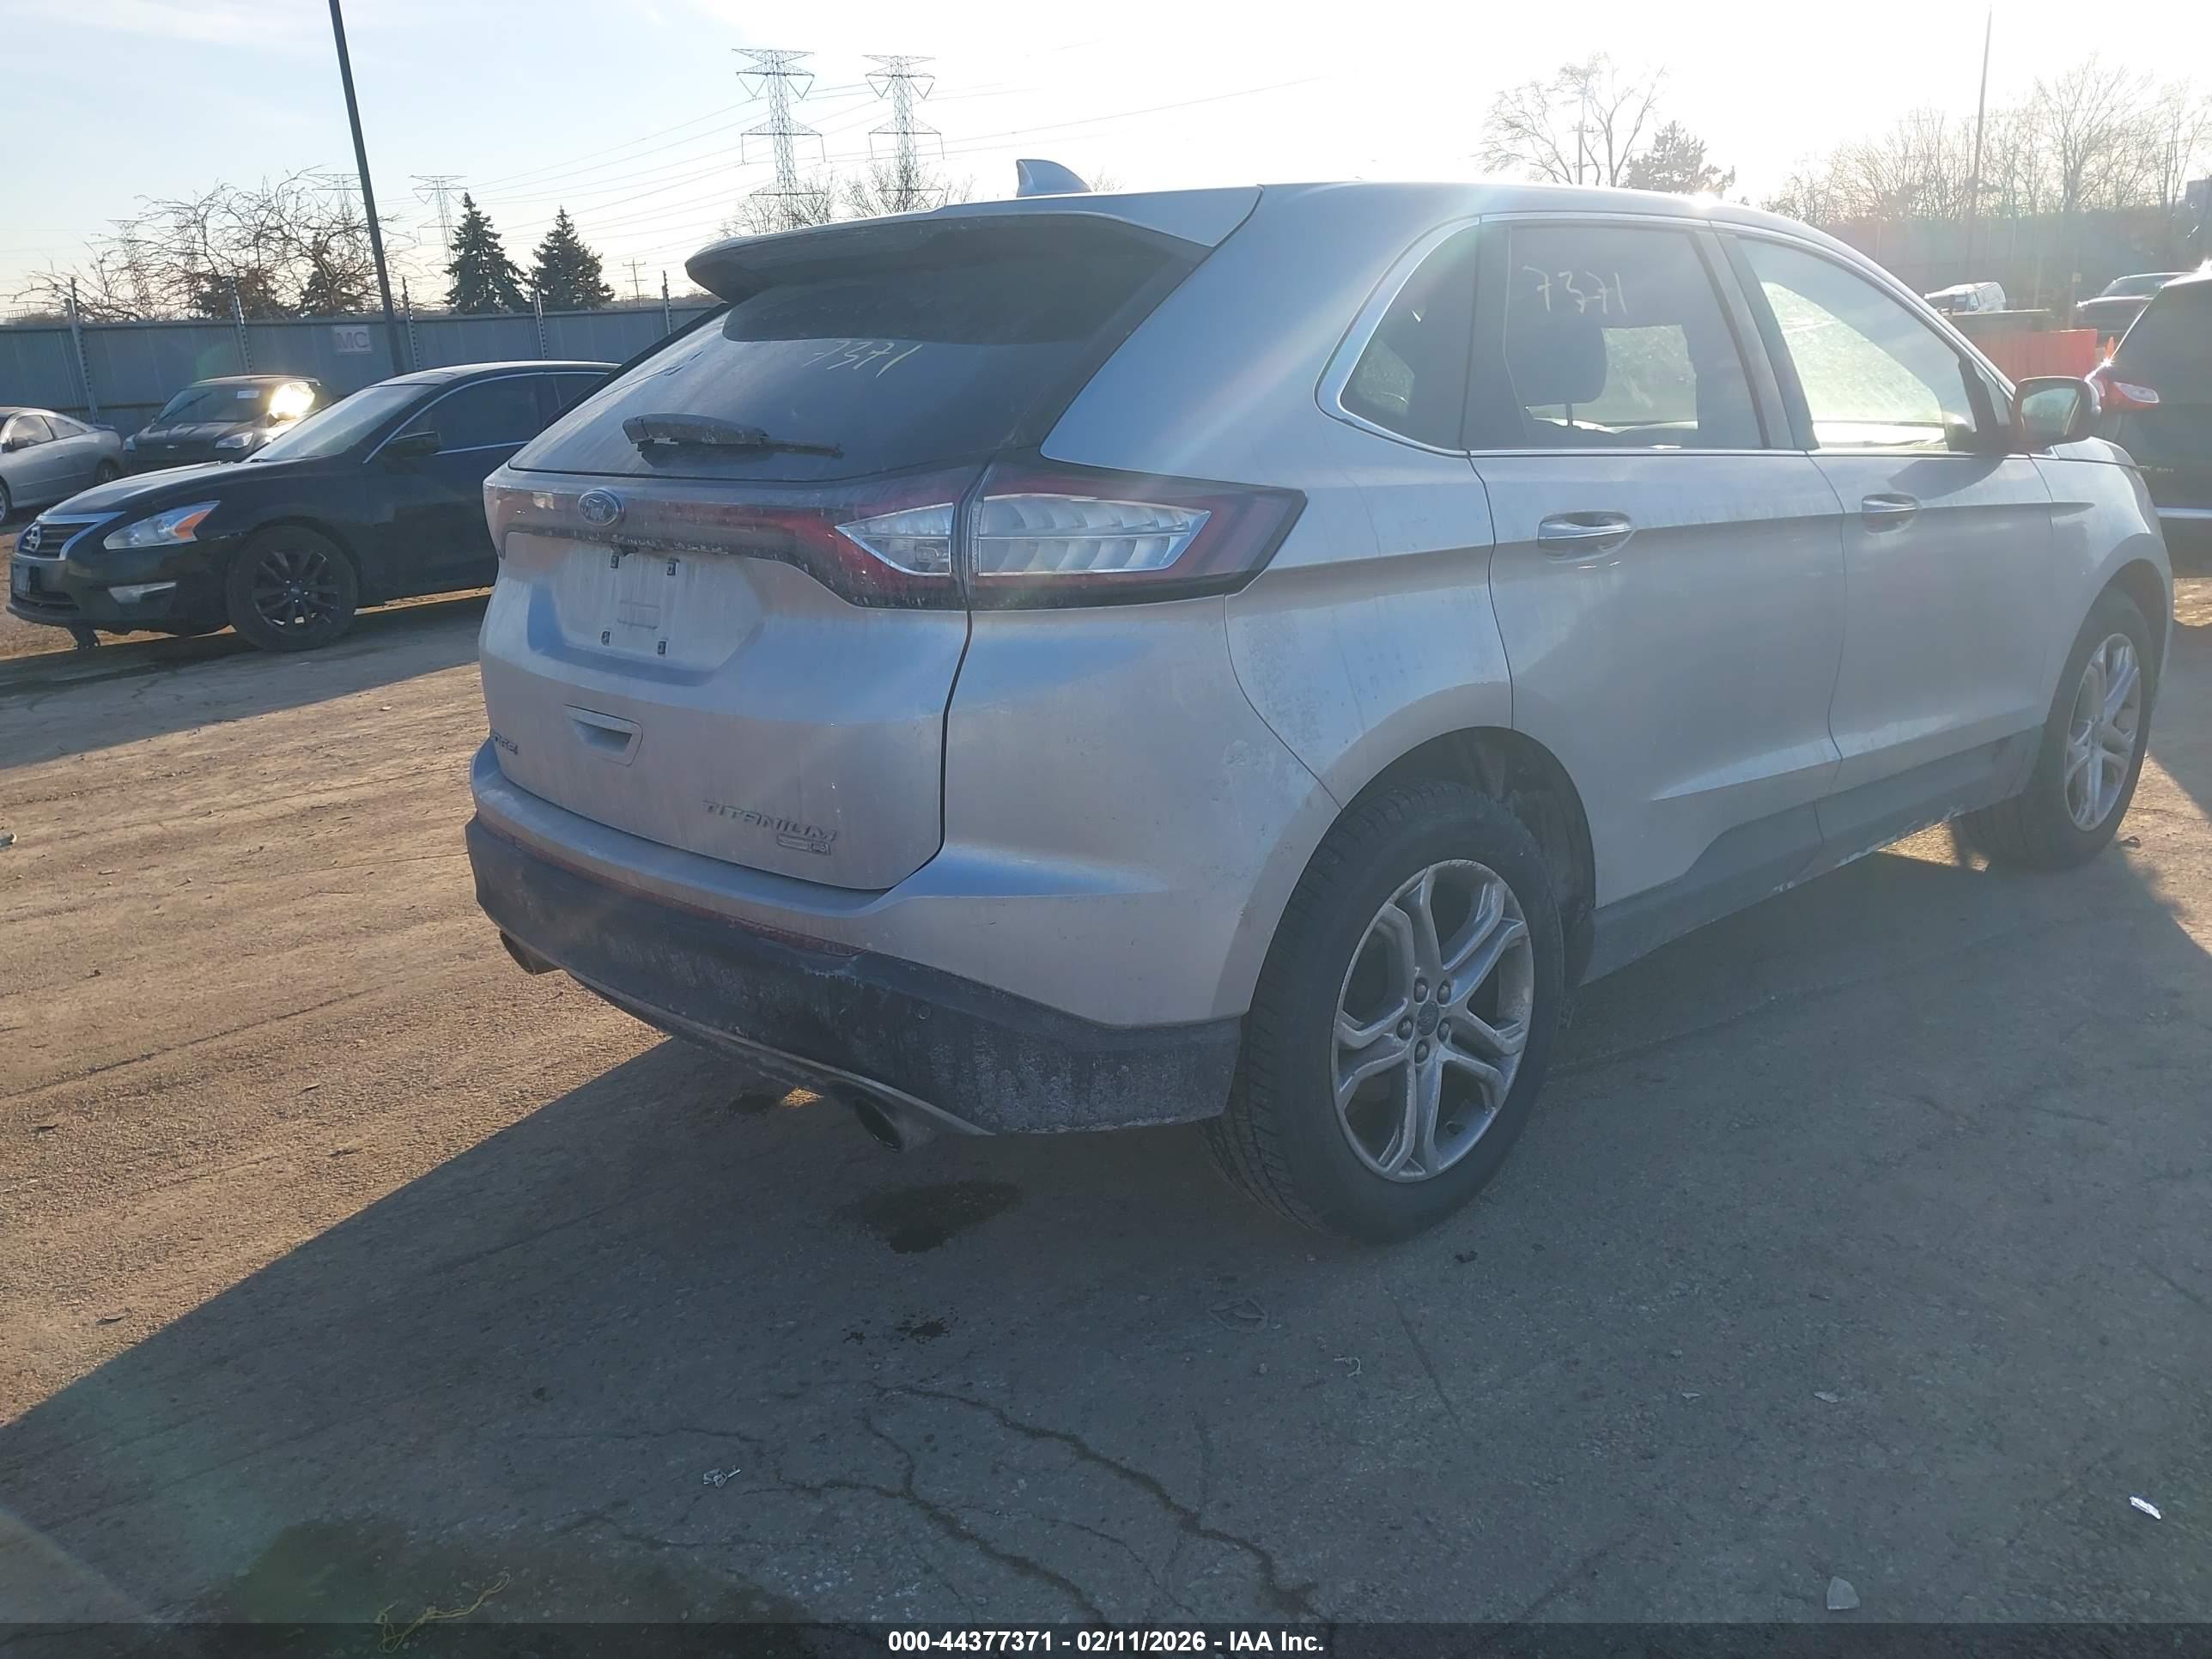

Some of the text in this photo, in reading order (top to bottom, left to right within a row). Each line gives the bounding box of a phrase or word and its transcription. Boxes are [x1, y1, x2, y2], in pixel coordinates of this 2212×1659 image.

[1522, 265, 1628, 314] 7371
[336, 331, 369, 349] MC
[702, 799, 838, 842] TITANIUM
